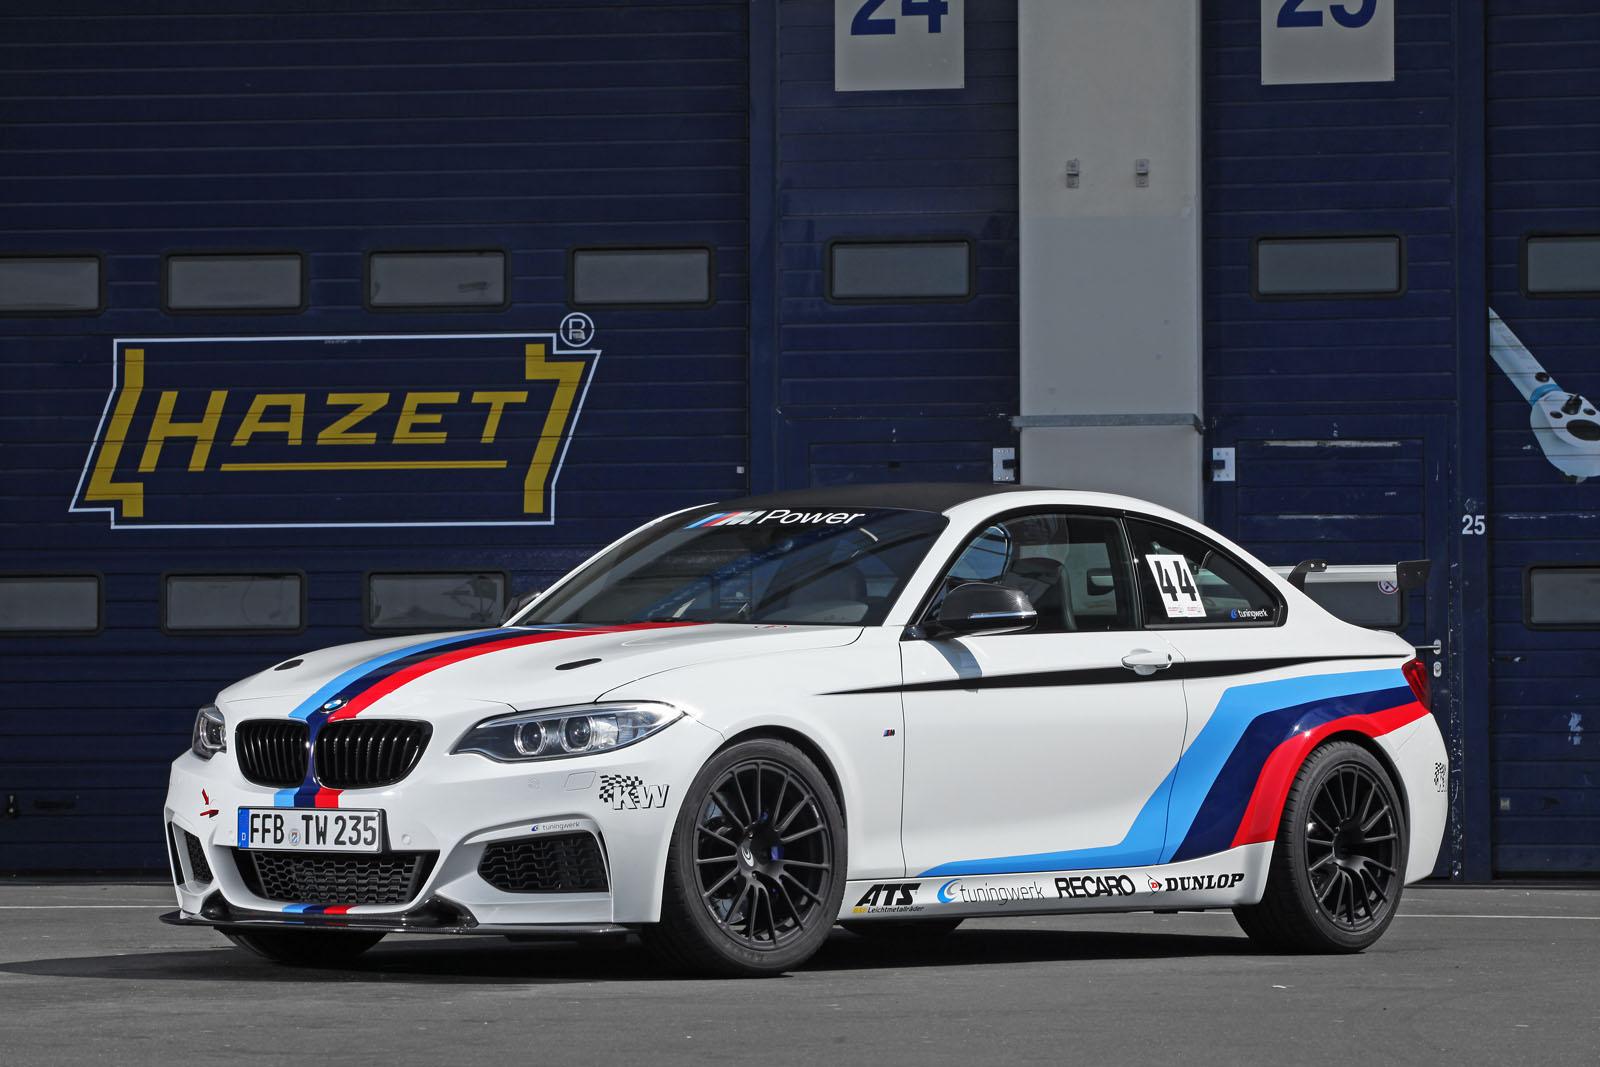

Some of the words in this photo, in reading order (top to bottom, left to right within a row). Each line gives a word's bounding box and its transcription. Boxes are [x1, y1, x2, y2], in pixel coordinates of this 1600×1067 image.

[138, 390, 528, 472] HAZET
[1462, 514, 1486, 535] 25
[1154, 560, 1198, 602] 44
[1238, 608, 1269, 620] tuningwerk
[613, 784, 670, 811] KW
[250, 813, 284, 845] FFB
[301, 814, 328, 846] TW
[334, 815, 377, 847] 235
[542, 821, 580, 833] tuningwerk
[959, 881, 1045, 906] tuningwerk
[1054, 874, 1136, 899] RECARO
[1165, 873, 1245, 892] DUNLOP
[855, 883, 921, 907] ATS
[867, 905, 925, 914] Leichtmetallräder
